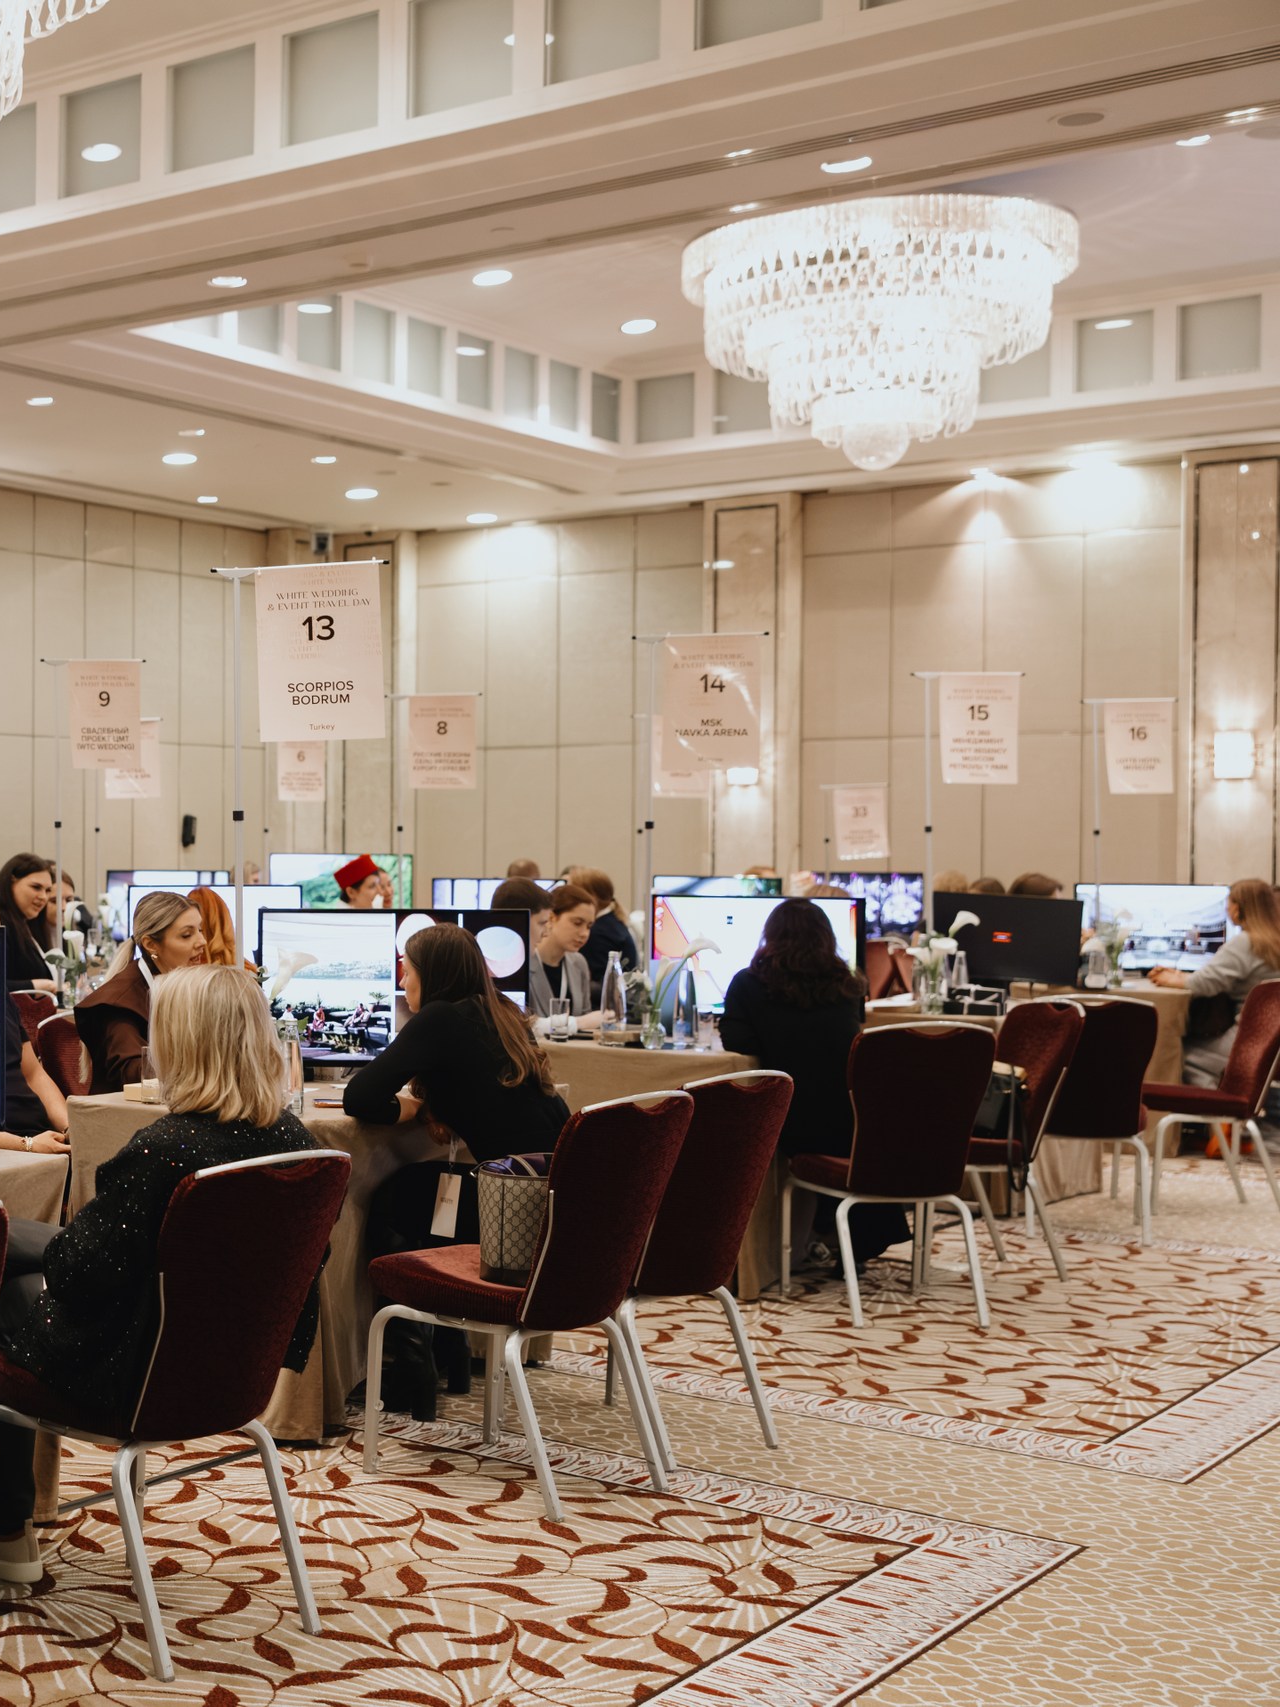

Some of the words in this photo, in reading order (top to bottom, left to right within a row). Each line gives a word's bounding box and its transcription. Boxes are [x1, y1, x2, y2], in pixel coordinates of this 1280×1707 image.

[276, 591, 308, 600] WHITE
[311, 588, 359, 598] WEDDING
[267, 603, 275, 611] &
[277, 601, 309, 611] EVENT
[313, 599, 351, 609] TRAVEL
[352, 598, 372, 607] DAY
[302, 615, 335, 641] 13
[287, 680, 354, 693] SCORPIOS
[699, 673, 726, 693] 14
[98, 690, 111, 707] 9
[292, 693, 350, 706] BODRUM
[968, 704, 989, 721] 15
[309, 723, 336, 731] Turkey
[436, 720, 448, 735] 8
[700, 718, 723, 727] MSK
[80, 726, 129, 735] СВАДЕБНЫЙ
[712, 728, 749, 737] ARENA
[1129, 726, 1147, 741] 16
[297, 750, 306, 762] 6
